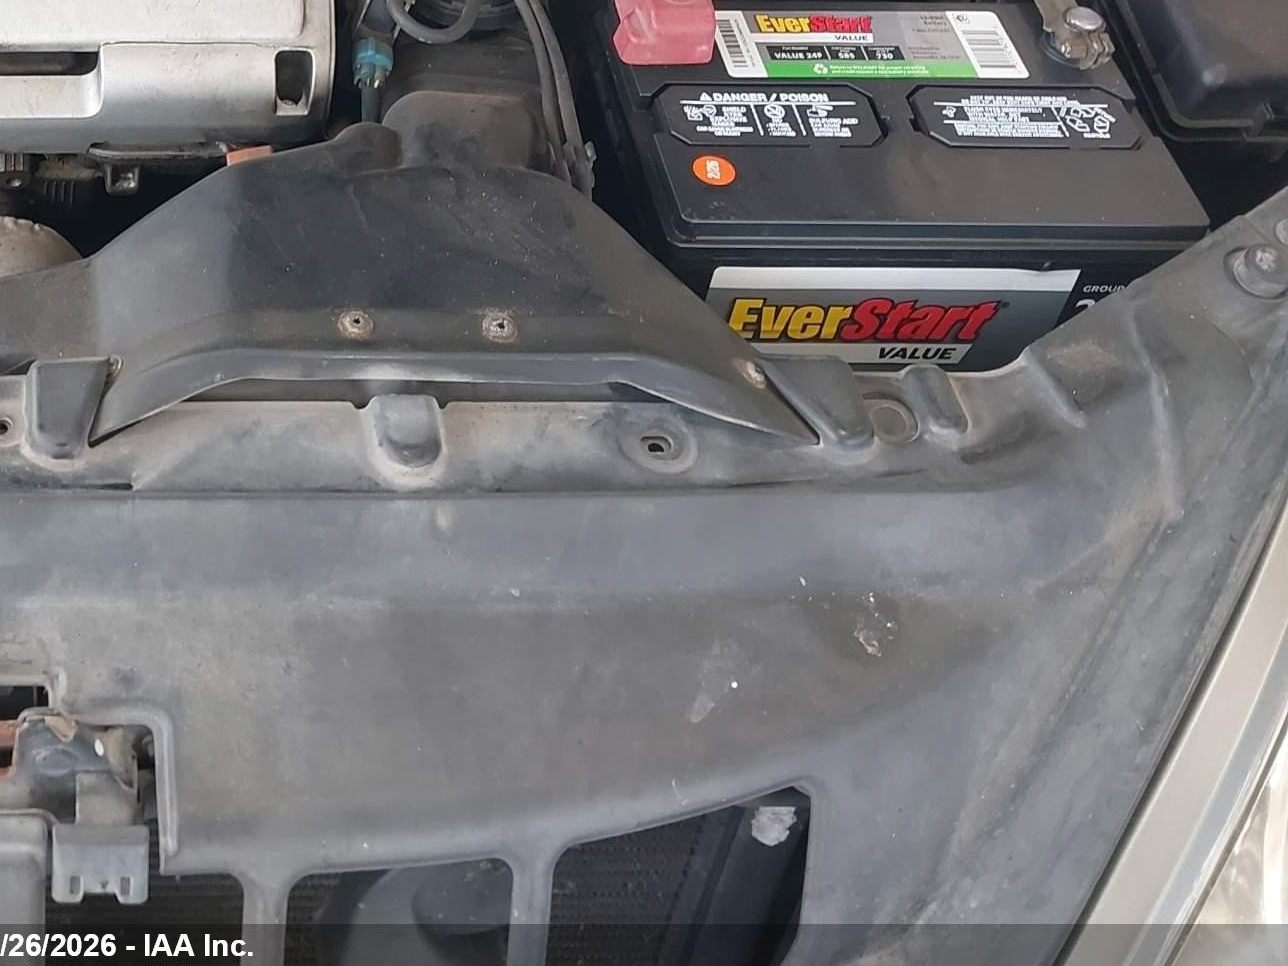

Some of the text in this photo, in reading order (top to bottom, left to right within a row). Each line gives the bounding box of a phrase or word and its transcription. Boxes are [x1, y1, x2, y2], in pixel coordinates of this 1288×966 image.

[754, 13, 872, 33] EverStart
[712, 92, 767, 102] DANGER
[779, 92, 829, 102] POISON
[727, 297, 999, 342] EverStart
[878, 346, 958, 361] VALUE
